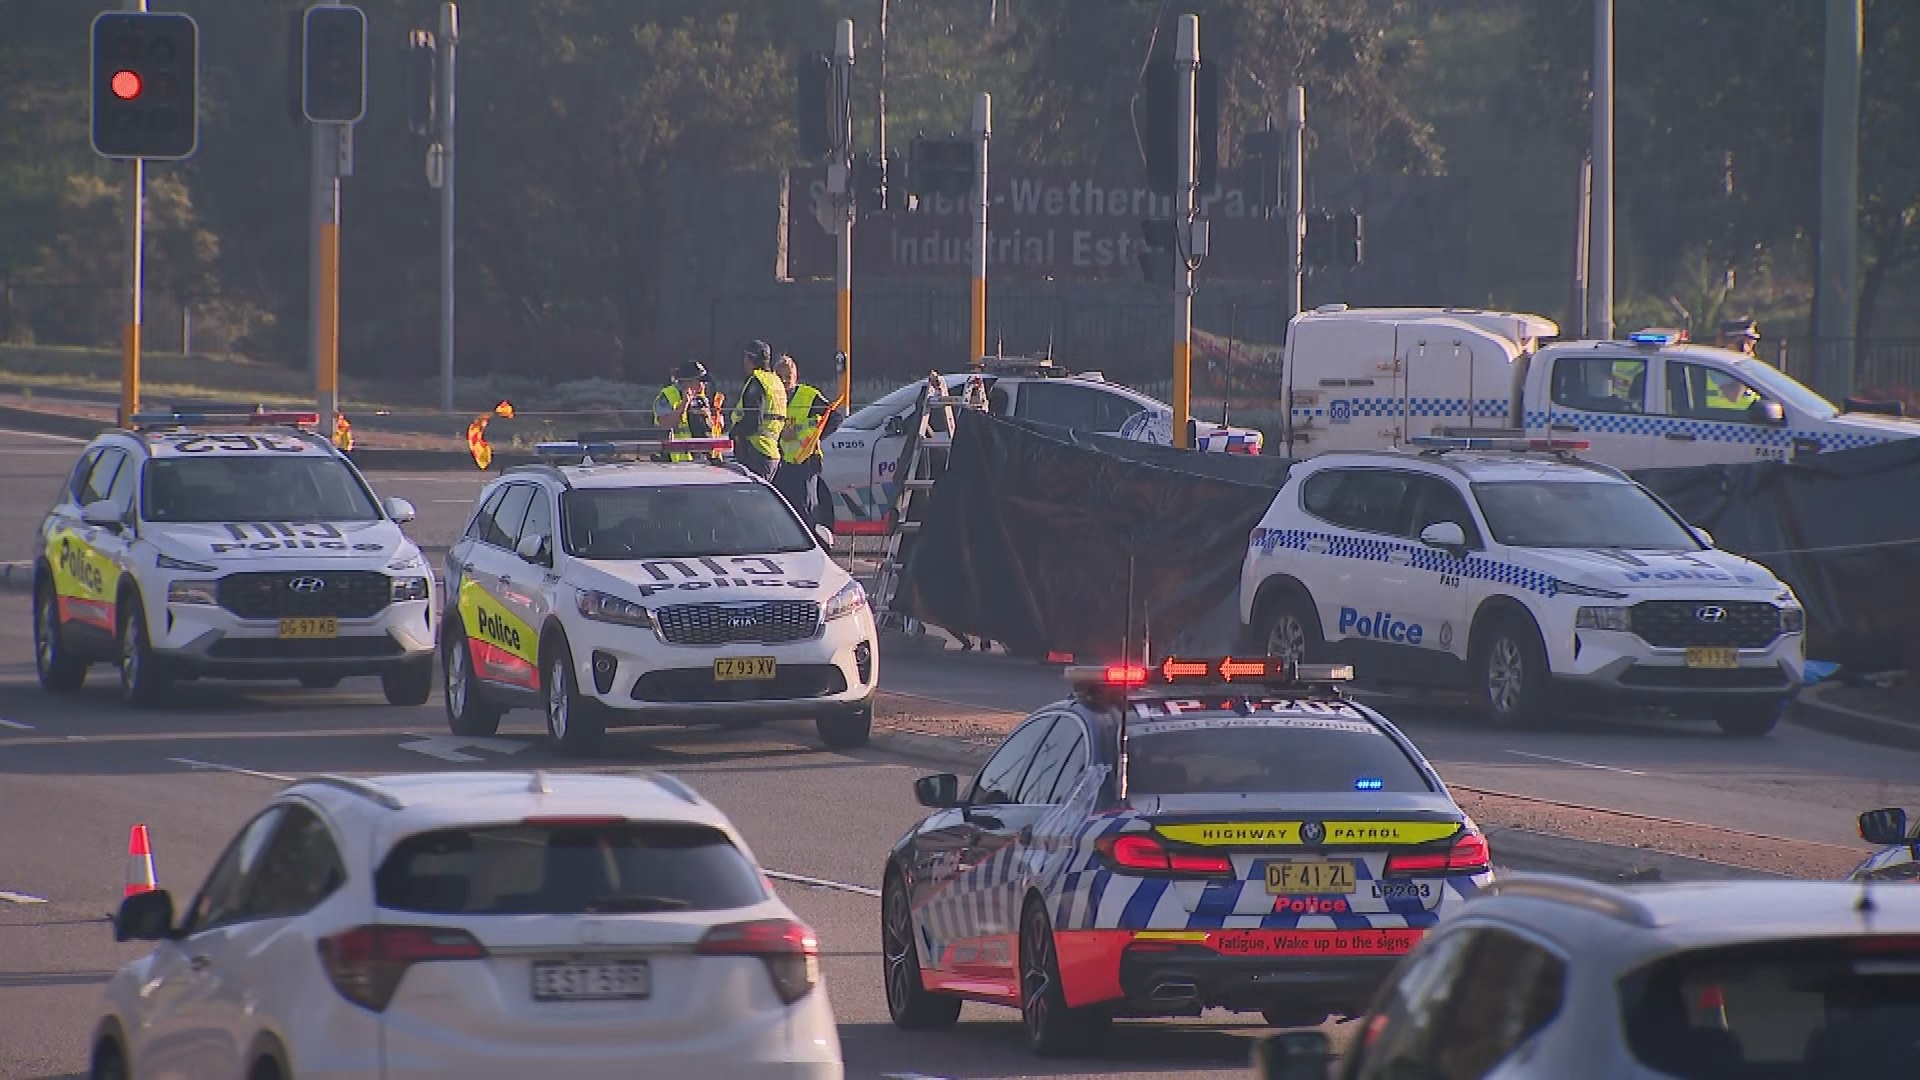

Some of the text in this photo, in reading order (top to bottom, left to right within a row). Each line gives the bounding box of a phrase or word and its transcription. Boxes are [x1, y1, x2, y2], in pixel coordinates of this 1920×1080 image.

[60, 535, 103, 595] Police
[637, 577, 820, 597] Police
[478, 606, 521, 651] Police
[1339, 606, 1423, 645] Police
[717, 659, 773, 675] CZ 93 XV
[1203, 829, 1400, 839] HIGHWAY PATROL
[1269, 865, 1352, 887] DF 41 ZL
[1371, 884, 1431, 899] LP203
[1274, 896, 1346, 912] Police
[1218, 936, 1270, 951] Fatigue,
[1273, 937, 1309, 949] Wake
[1314, 939, 1330, 952] up
[1335, 937, 1348, 949] to
[1352, 937, 1372, 949] the
